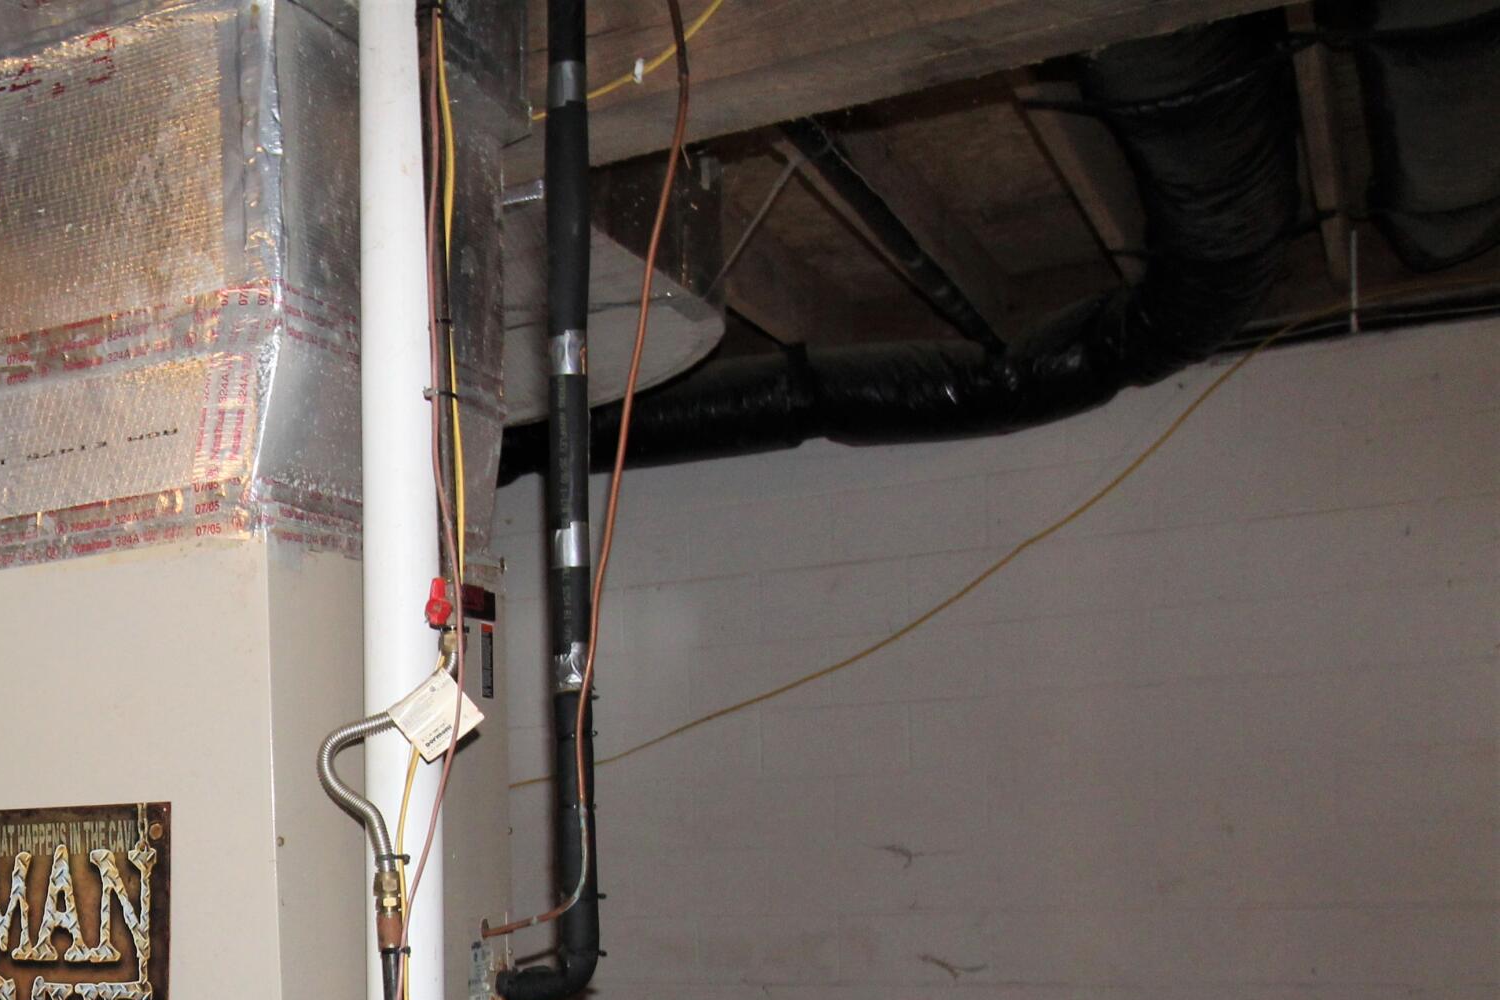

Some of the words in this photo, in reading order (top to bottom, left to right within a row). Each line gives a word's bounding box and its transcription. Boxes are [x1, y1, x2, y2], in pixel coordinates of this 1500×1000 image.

[108, 350, 131, 363] 324A
[115, 512, 140, 525] 324A
[195, 500, 221, 515] 07/05
[115, 533, 140, 546] 324A
[196, 522, 221, 537] 07/05
[17, 822, 67, 857] HAPPENS
[69, 821, 81, 855] IN
[83, 820, 106, 853] THE
